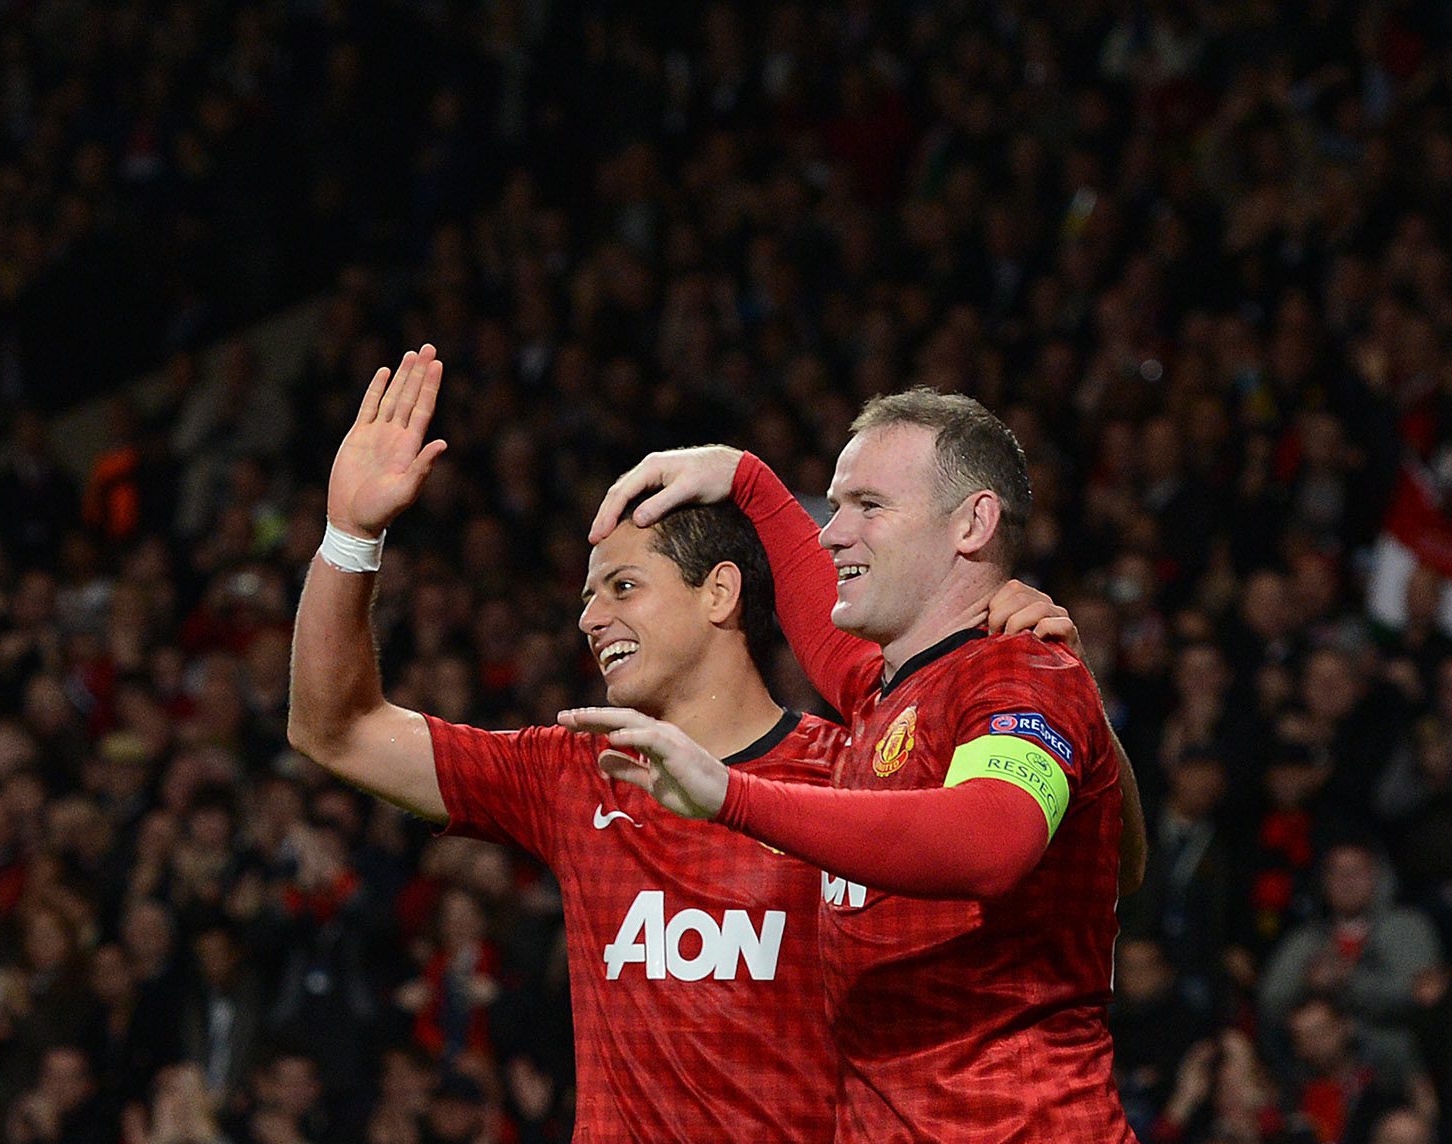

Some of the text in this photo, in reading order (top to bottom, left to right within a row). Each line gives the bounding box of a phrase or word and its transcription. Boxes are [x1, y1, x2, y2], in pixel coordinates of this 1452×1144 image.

[1019, 718, 1073, 760] RESPECT
[988, 758, 1059, 818] RESPECT
[603, 890, 786, 982] AON
